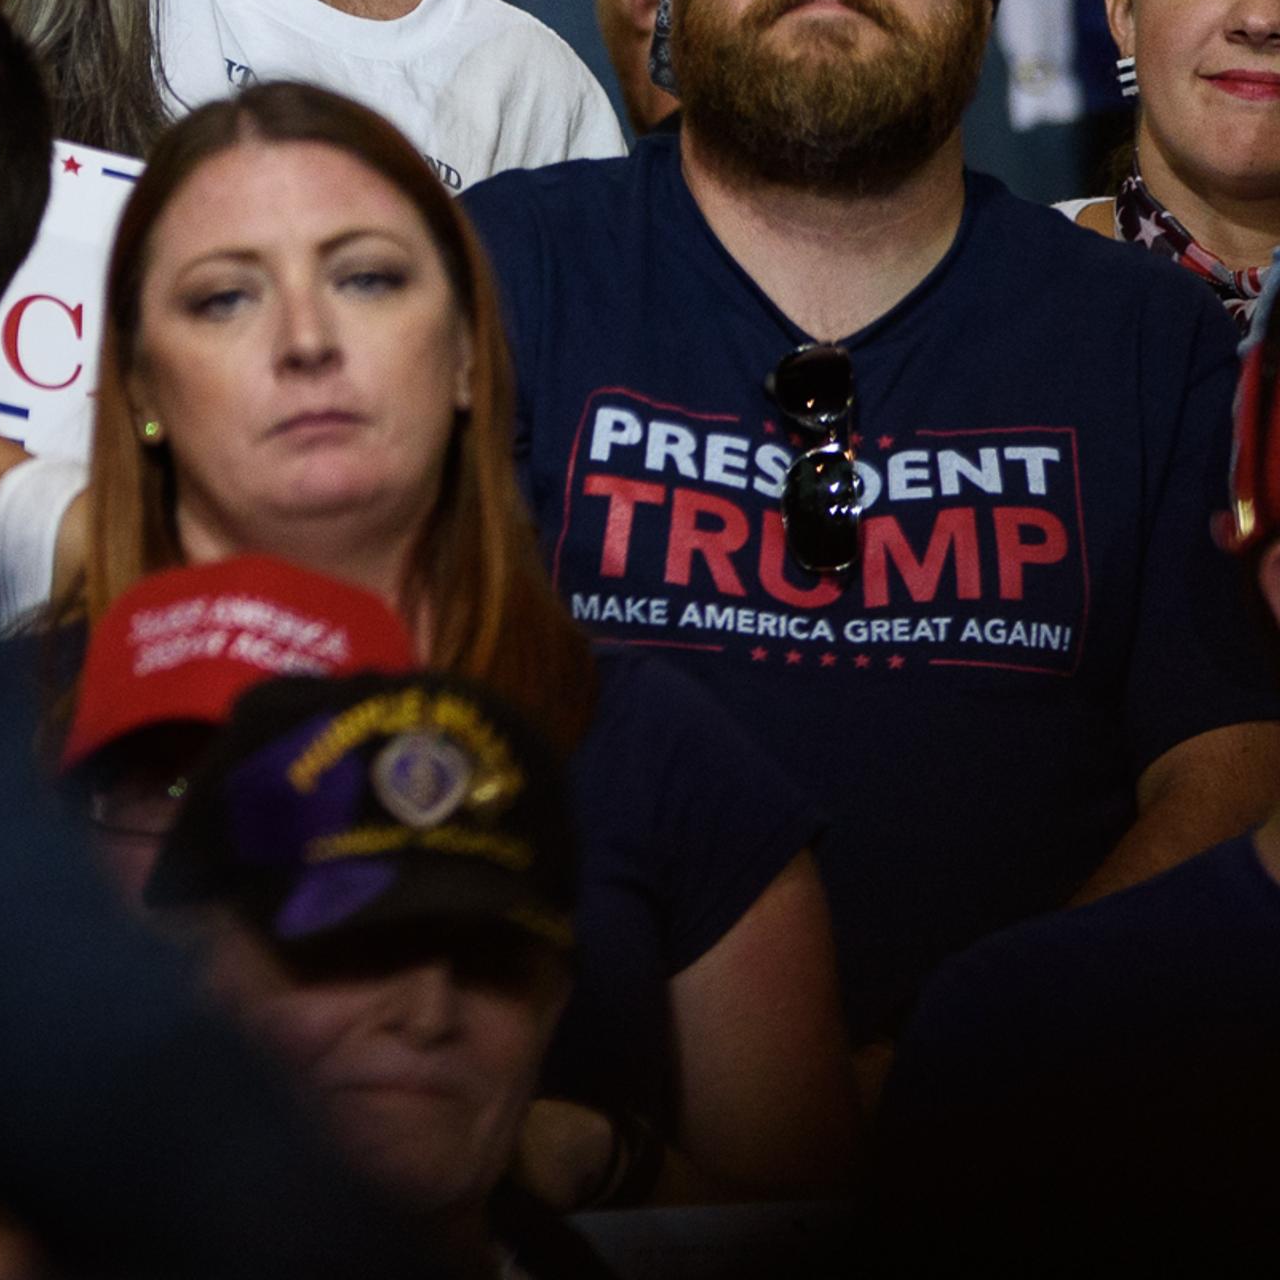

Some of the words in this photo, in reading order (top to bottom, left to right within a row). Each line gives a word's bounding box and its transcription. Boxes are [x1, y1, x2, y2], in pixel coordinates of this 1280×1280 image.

[589, 406, 1060, 510] PRESDENT
[583, 473, 1069, 609] TRUMP
[571, 592, 669, 627] MAKE
[678, 602, 835, 643] AMERICA
[843, 616, 952, 644] GREAT
[960, 617, 1073, 653] AGAIN!
